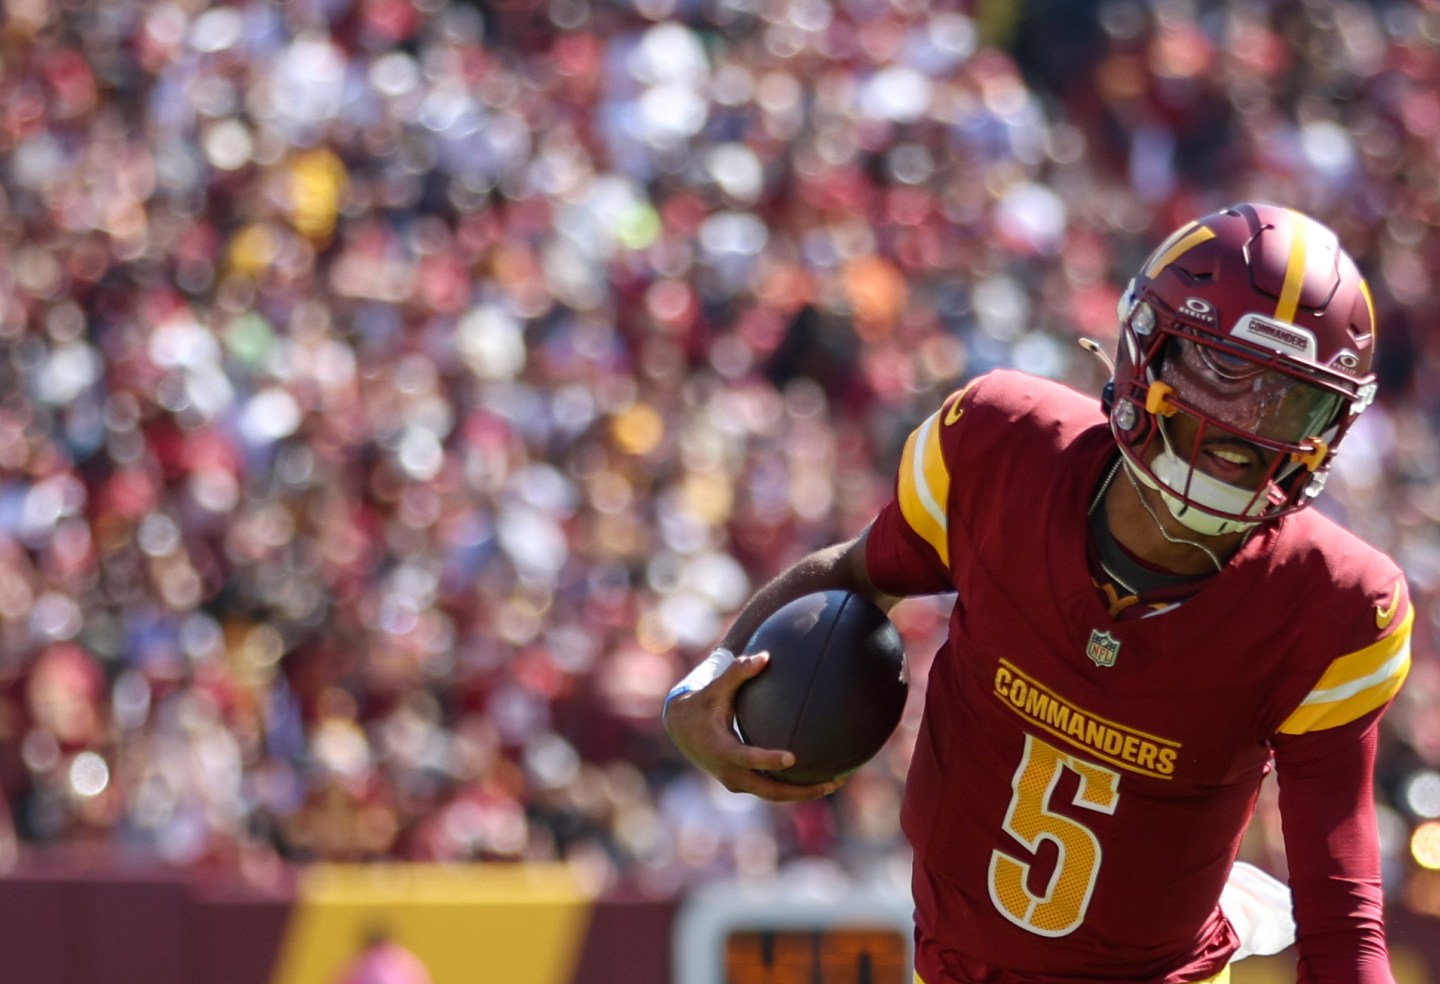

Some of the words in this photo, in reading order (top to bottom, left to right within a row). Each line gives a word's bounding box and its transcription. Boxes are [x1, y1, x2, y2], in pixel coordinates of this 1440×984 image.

[1248, 320, 1308, 349] COMMANDERS
[994, 667, 1178, 775] COMMANDERS
[987, 731, 1121, 938] 5
